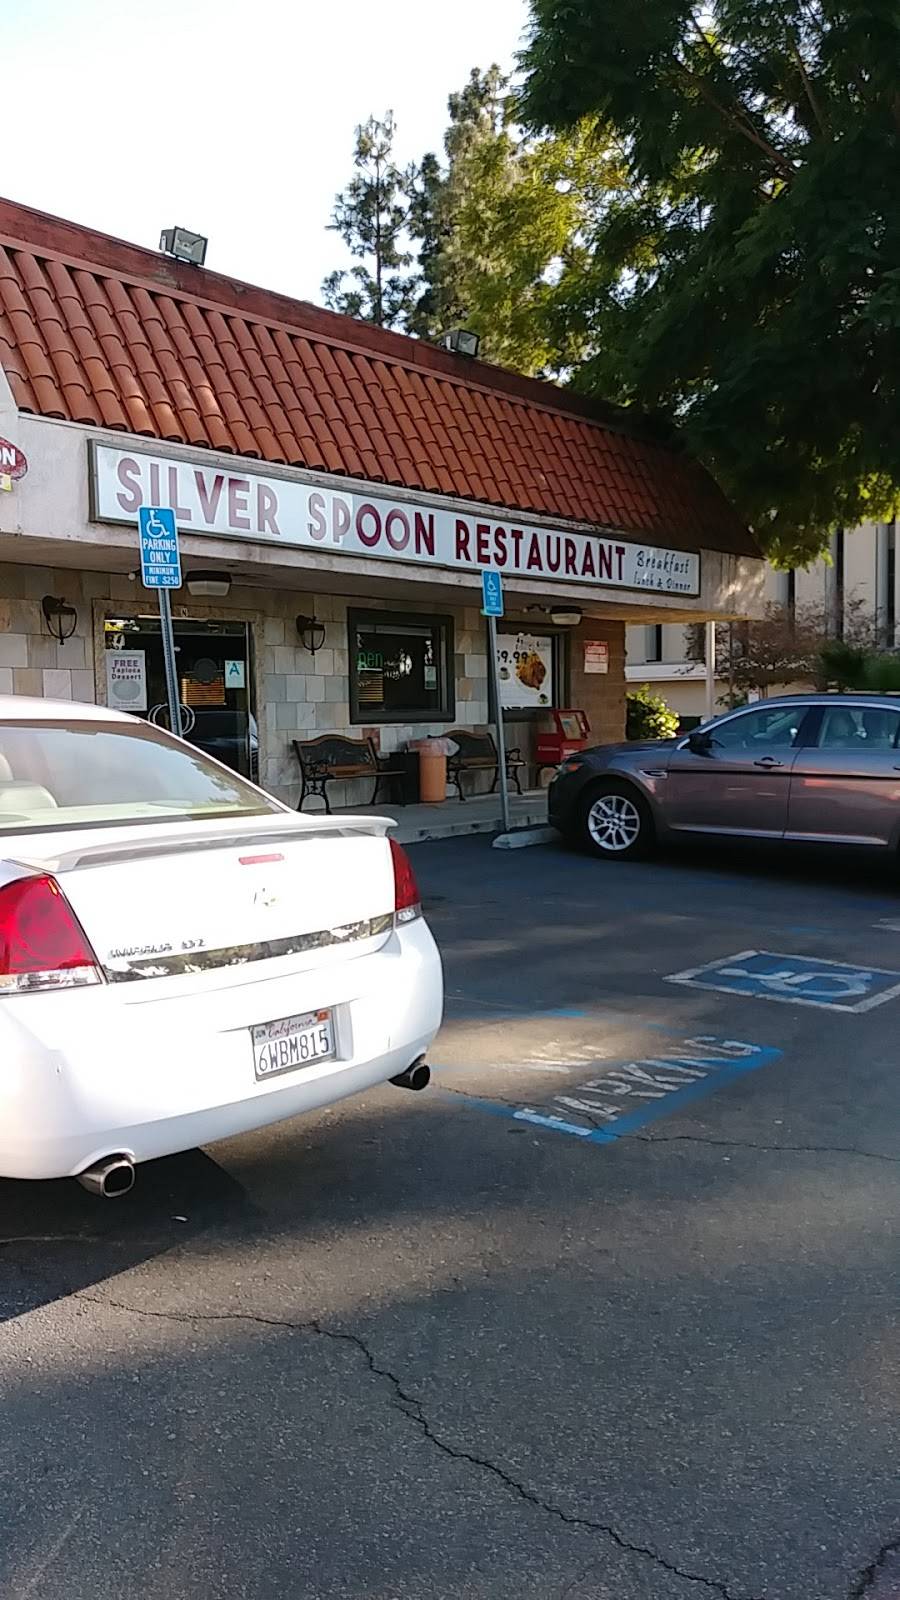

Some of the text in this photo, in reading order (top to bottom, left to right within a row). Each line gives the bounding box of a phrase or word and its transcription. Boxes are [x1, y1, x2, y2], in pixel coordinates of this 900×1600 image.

[0, 447, 17, 466] N
[116, 457, 626, 581] SILVER SPOON RESTAURANT
[143, 538, 176, 552] PARKING
[149, 551, 171, 564] ONLY
[636, 550, 690, 577] Breakfast
[113, 659, 139, 668] FREE
[229, 662, 241, 676] A
[259, 1027, 330, 1072] 6WBM815
